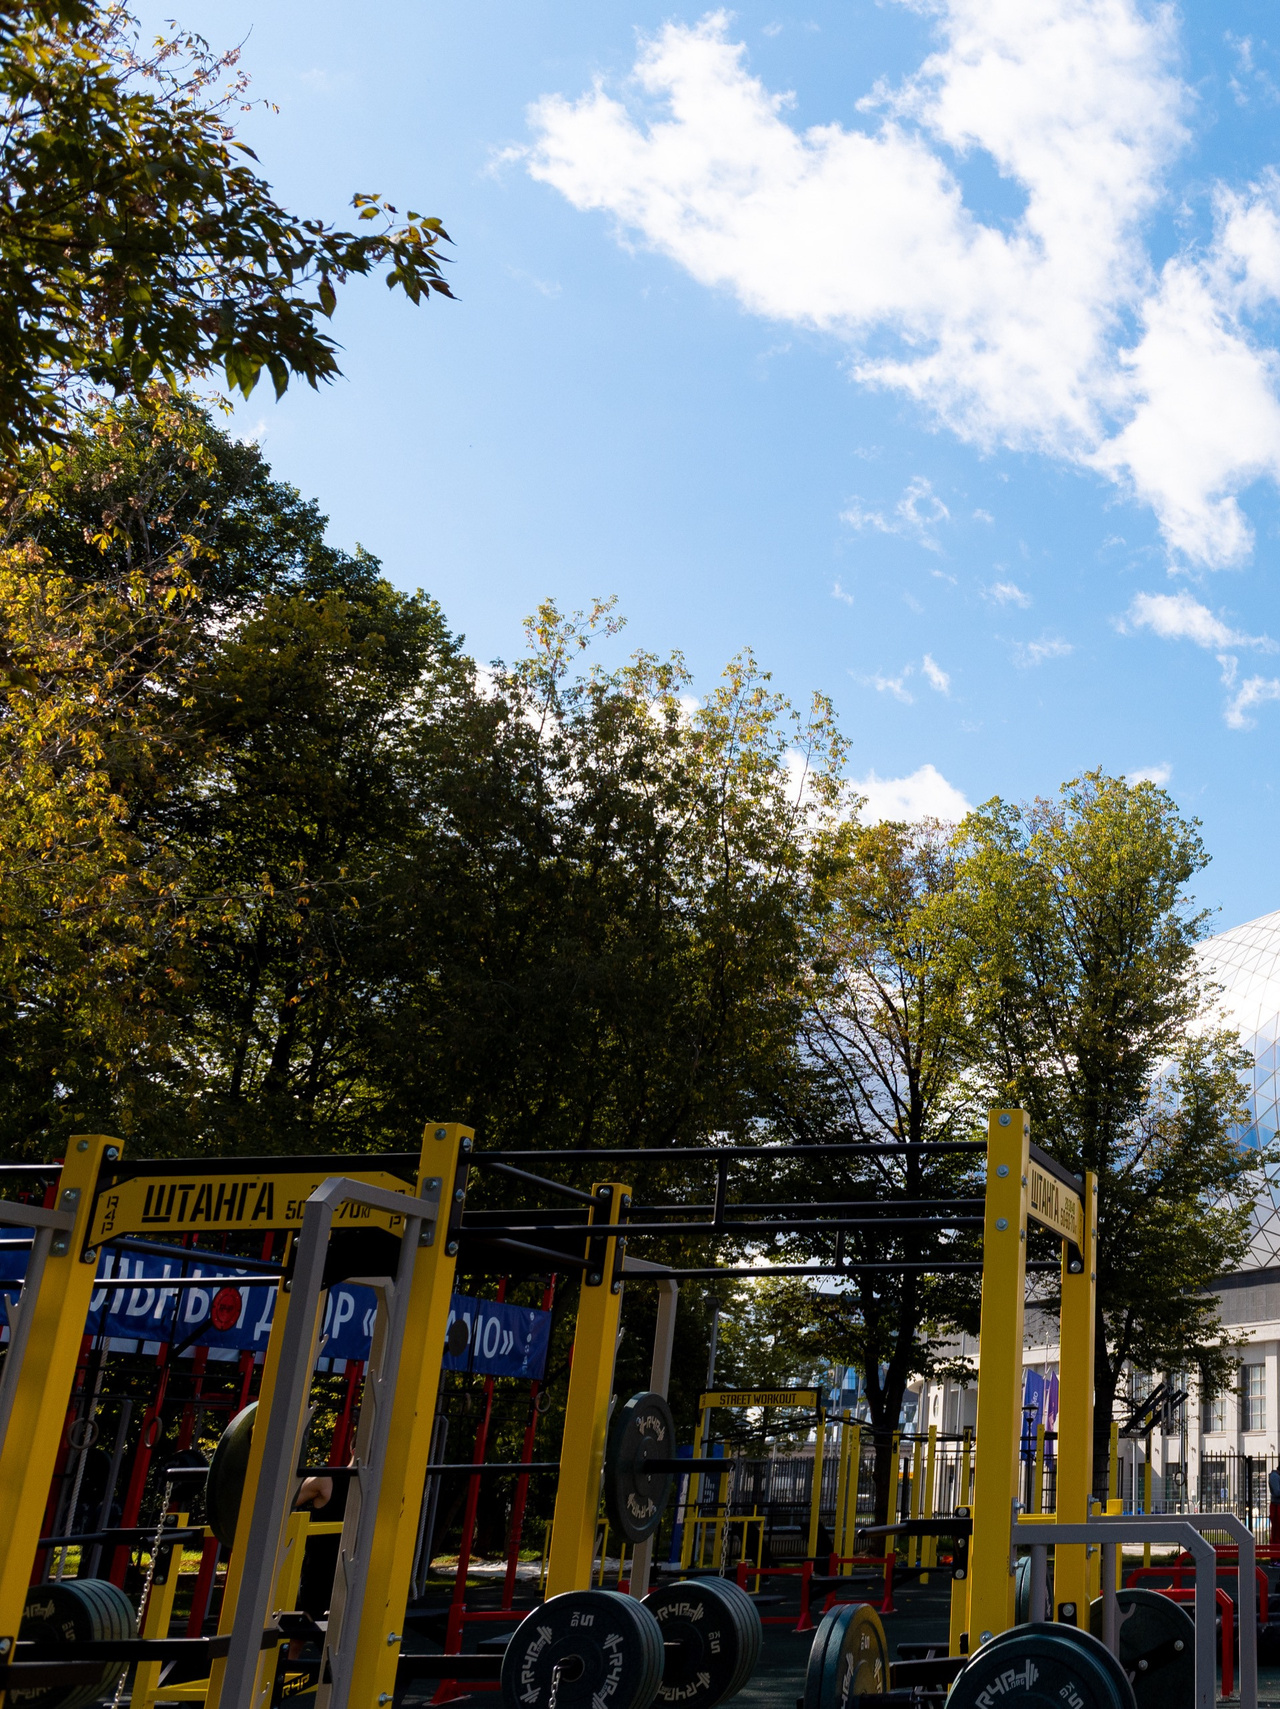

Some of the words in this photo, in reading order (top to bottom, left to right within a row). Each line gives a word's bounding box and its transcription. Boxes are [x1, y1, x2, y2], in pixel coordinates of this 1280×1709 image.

[141, 1181, 275, 1223] ШТАНГА
[1030, 1168, 1060, 1224] ШТАНГА
[100, 1196, 119, 1234] R4P
[719, 1394, 752, 1406] STREET
[753, 1393, 797, 1405] WORKOUT
[571, 1612, 580, 1627] KG
[580, 1614, 594, 1627] 5
[710, 1641, 721, 1654] 5
